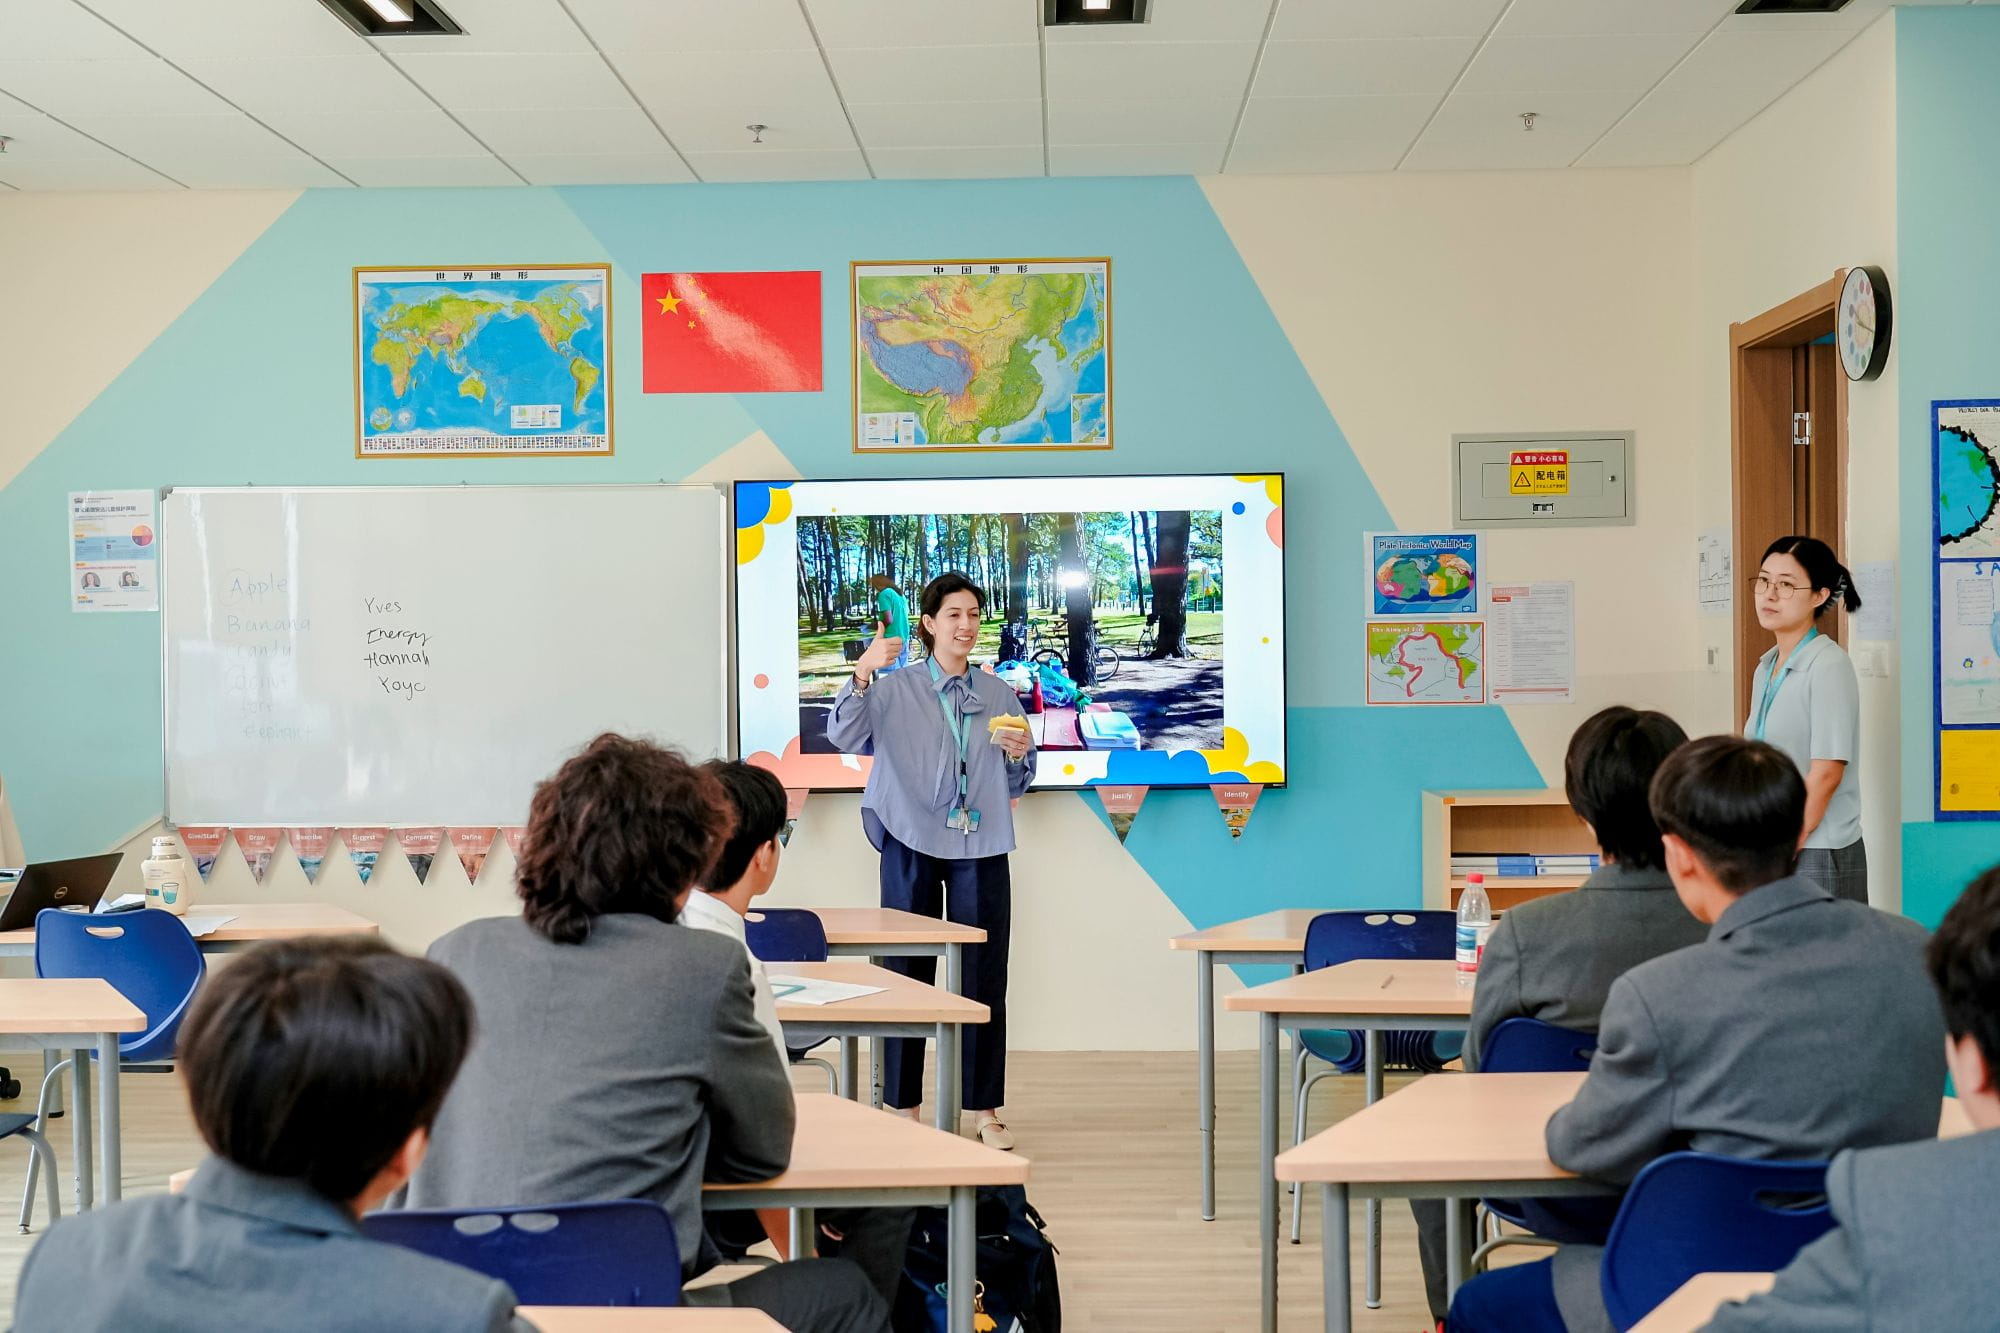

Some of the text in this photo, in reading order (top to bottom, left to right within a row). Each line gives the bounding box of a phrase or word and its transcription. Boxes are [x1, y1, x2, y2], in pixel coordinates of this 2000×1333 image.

[435, 271, 529, 281] 世界地形
[933, 264, 1029, 275] 中国地形
[1536, 470, 1566, 480] 配电箱
[1379, 539, 1472, 550] Plate Tectonics World Map
[230, 572, 288, 604] Apple
[364, 597, 402, 613] Yves
[227, 614, 311, 633] Banana
[366, 627, 432, 647] Energy
[363, 650, 430, 669] Hannah
[378, 675, 426, 701] Yoyo
[1112, 792, 1132, 800] Justify
[1224, 791, 1249, 799] Identify
